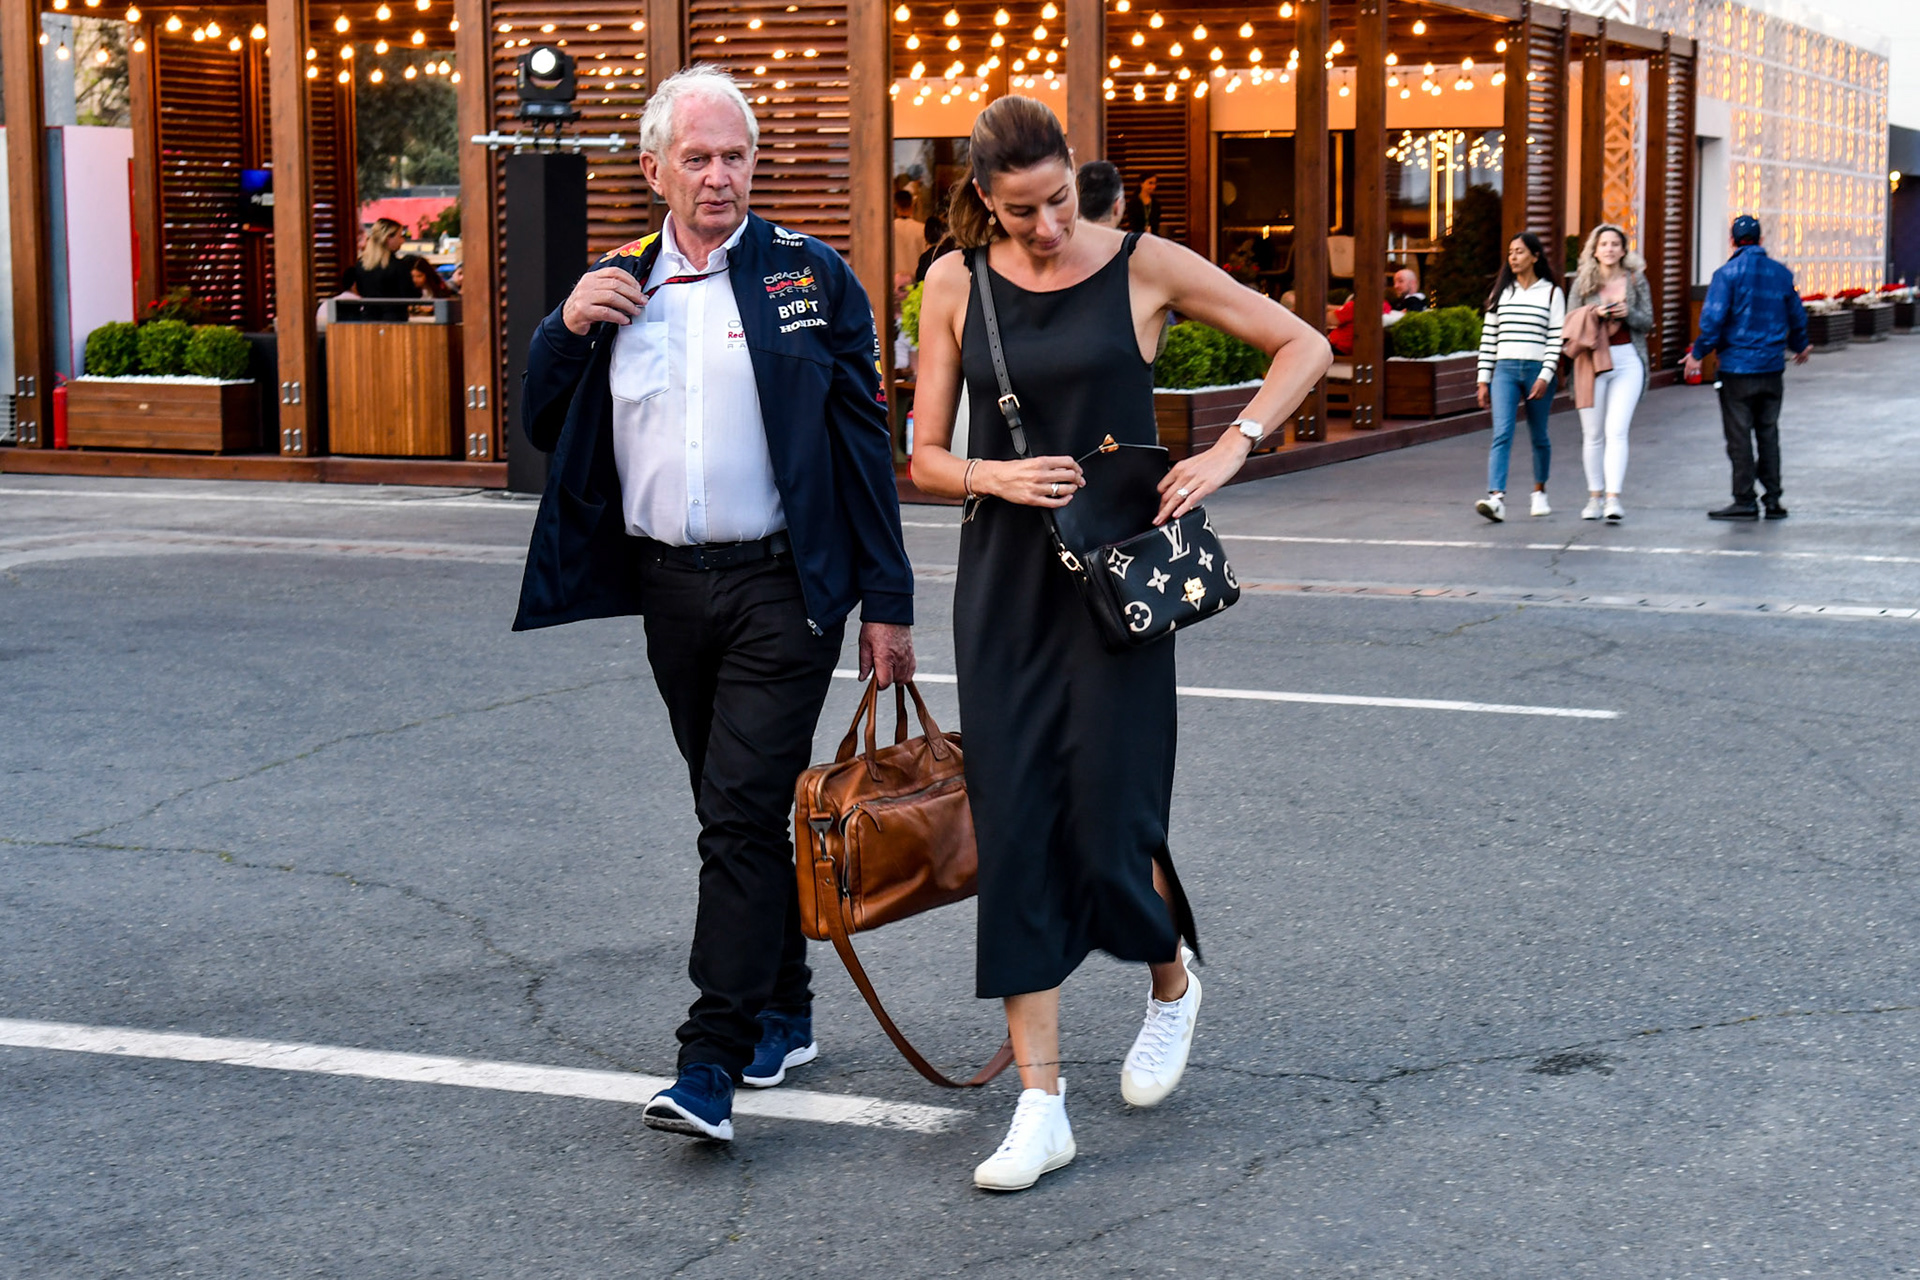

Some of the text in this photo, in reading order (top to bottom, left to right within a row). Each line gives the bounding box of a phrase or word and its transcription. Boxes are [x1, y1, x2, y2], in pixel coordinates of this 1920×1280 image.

[763, 266, 812, 285] ORACLE
[768, 284, 818, 299] RACING
[778, 298, 818, 319] BYBIT
[779, 318, 828, 333] HONDA
